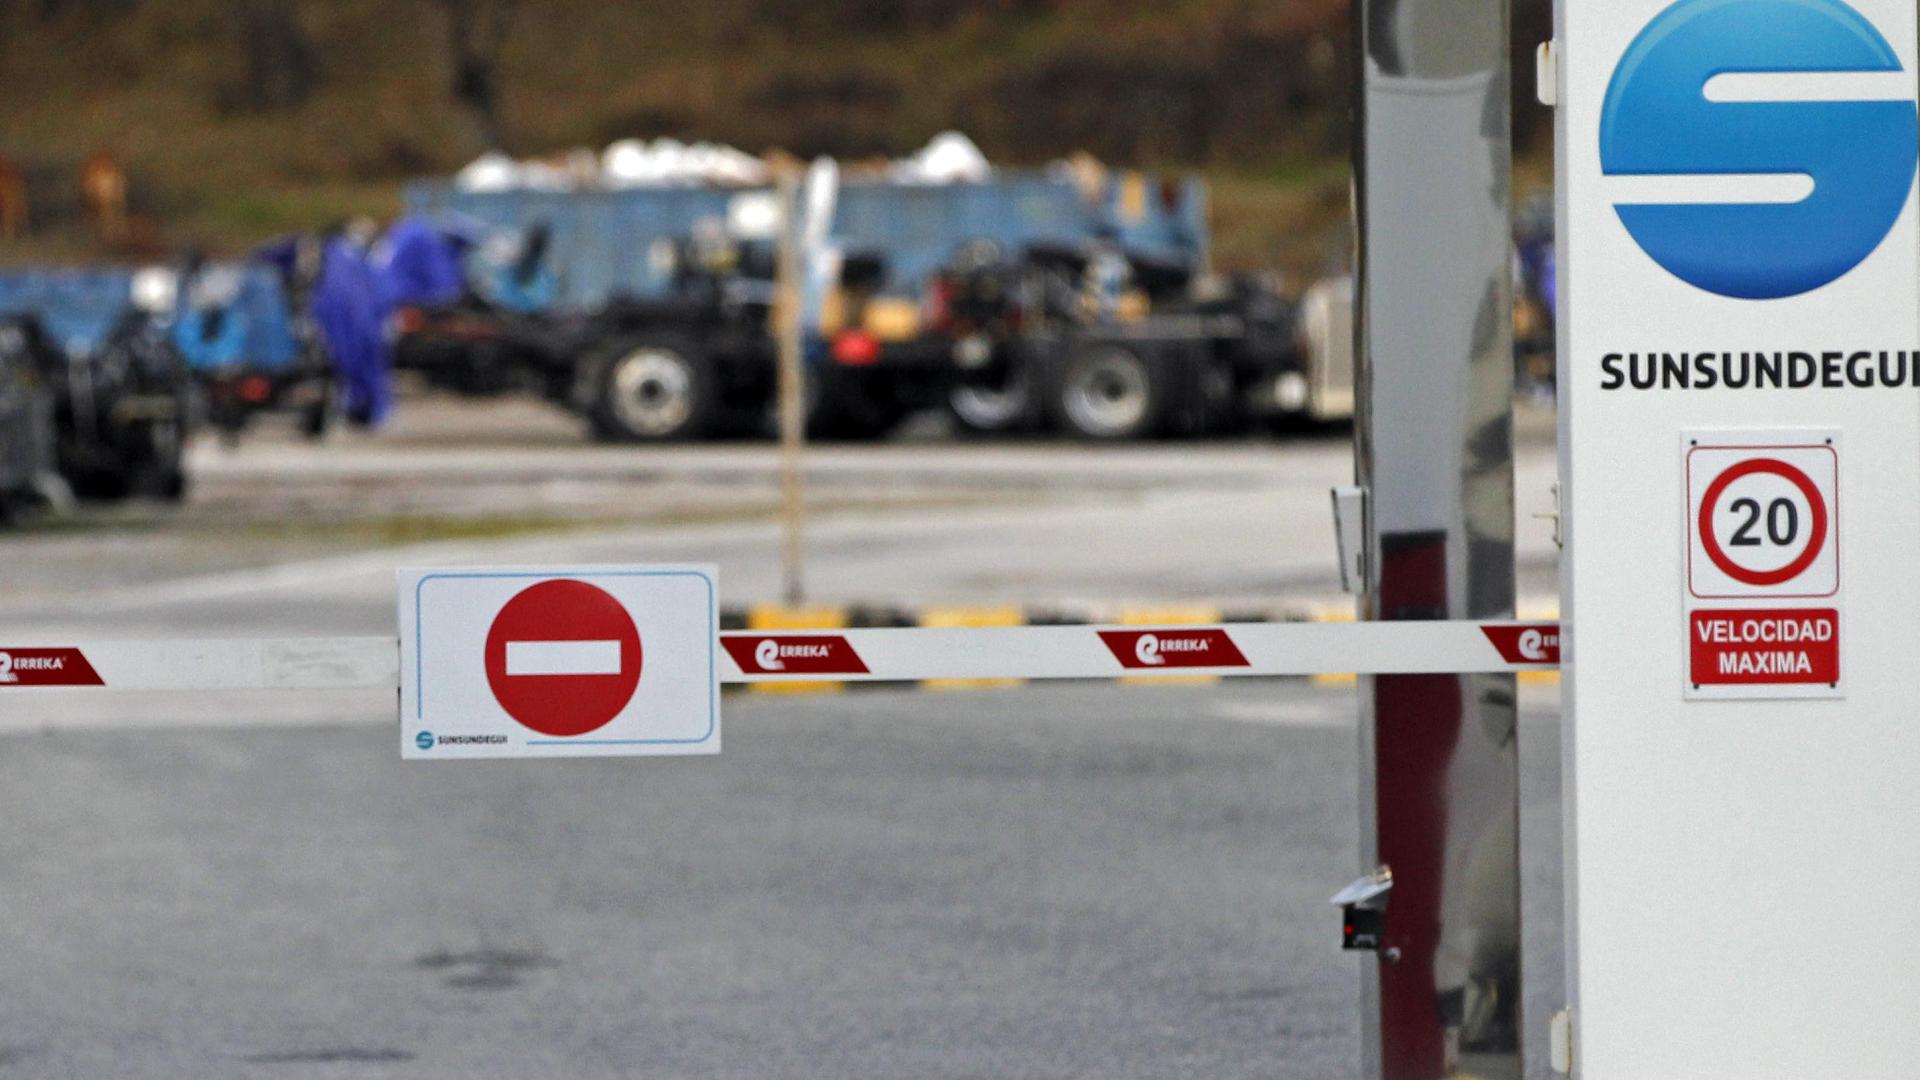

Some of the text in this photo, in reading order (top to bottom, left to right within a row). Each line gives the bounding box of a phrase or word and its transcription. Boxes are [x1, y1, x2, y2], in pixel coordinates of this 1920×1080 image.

[1600, 351, 1920, 390] SUNSUNDEGUI
[1729, 497, 1799, 546] 20
[1697, 619, 1832, 643] VELOCIDAD
[779, 645, 829, 657] ERREKA
[1160, 639, 1209, 652] ERREKA
[13, 657, 63, 670] ERREKA
[1719, 651, 1813, 674] MAXIMA
